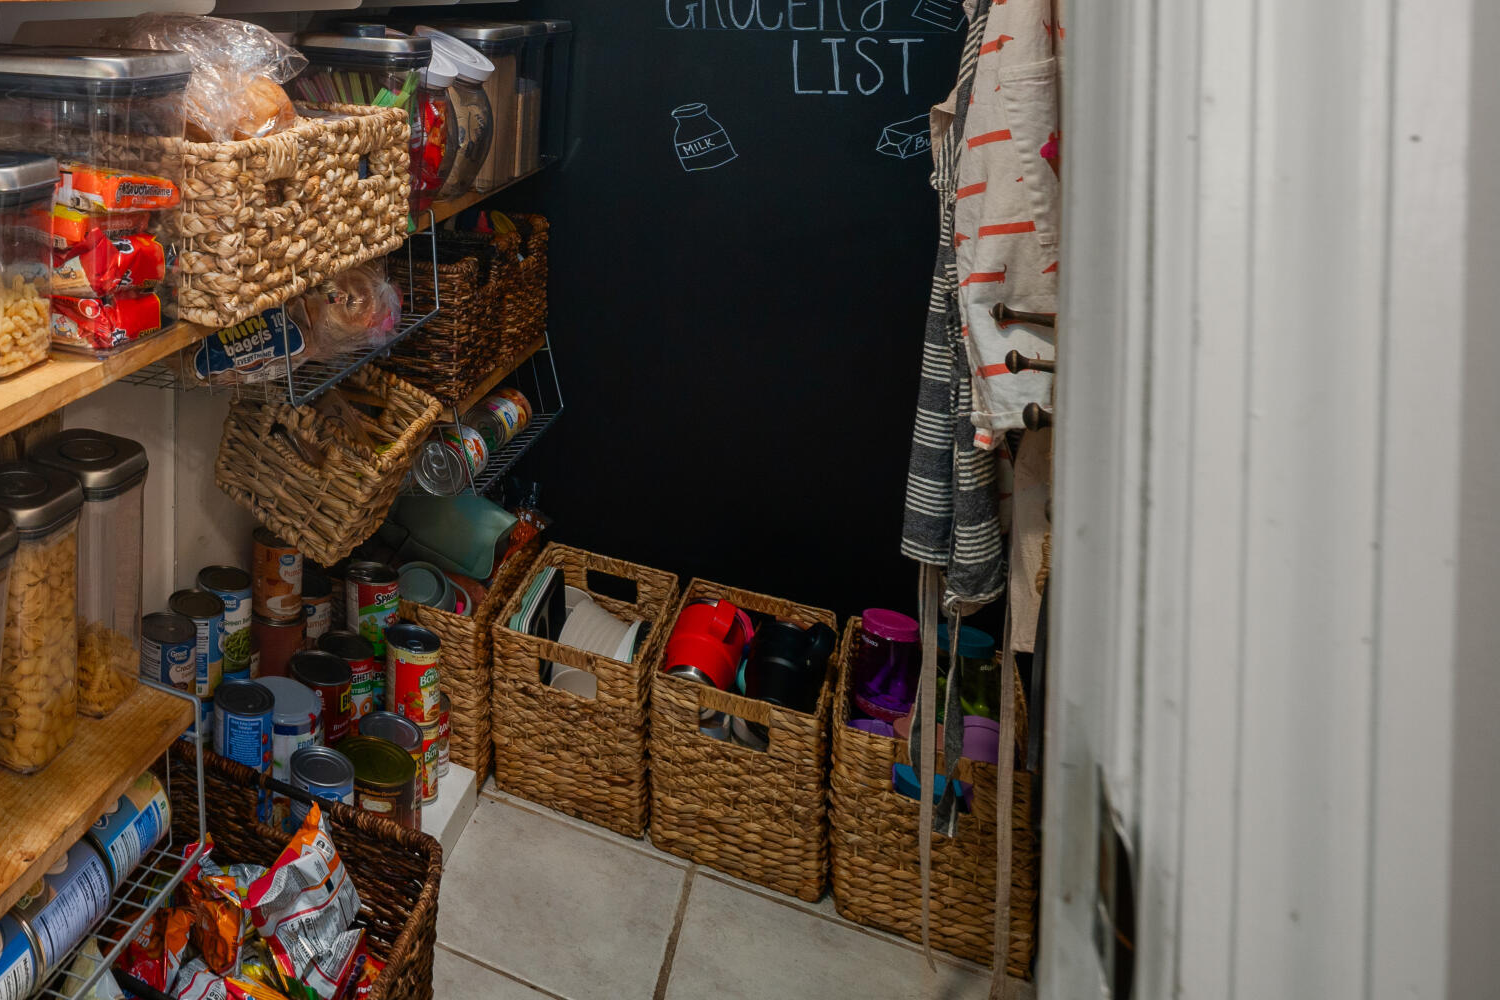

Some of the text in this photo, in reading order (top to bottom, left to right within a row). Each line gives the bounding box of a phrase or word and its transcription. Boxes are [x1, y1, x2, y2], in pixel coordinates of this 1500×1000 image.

[792, 37, 924, 96] LIST
[682, 138, 716, 156] MILK
[223, 329, 272, 357] bagels
